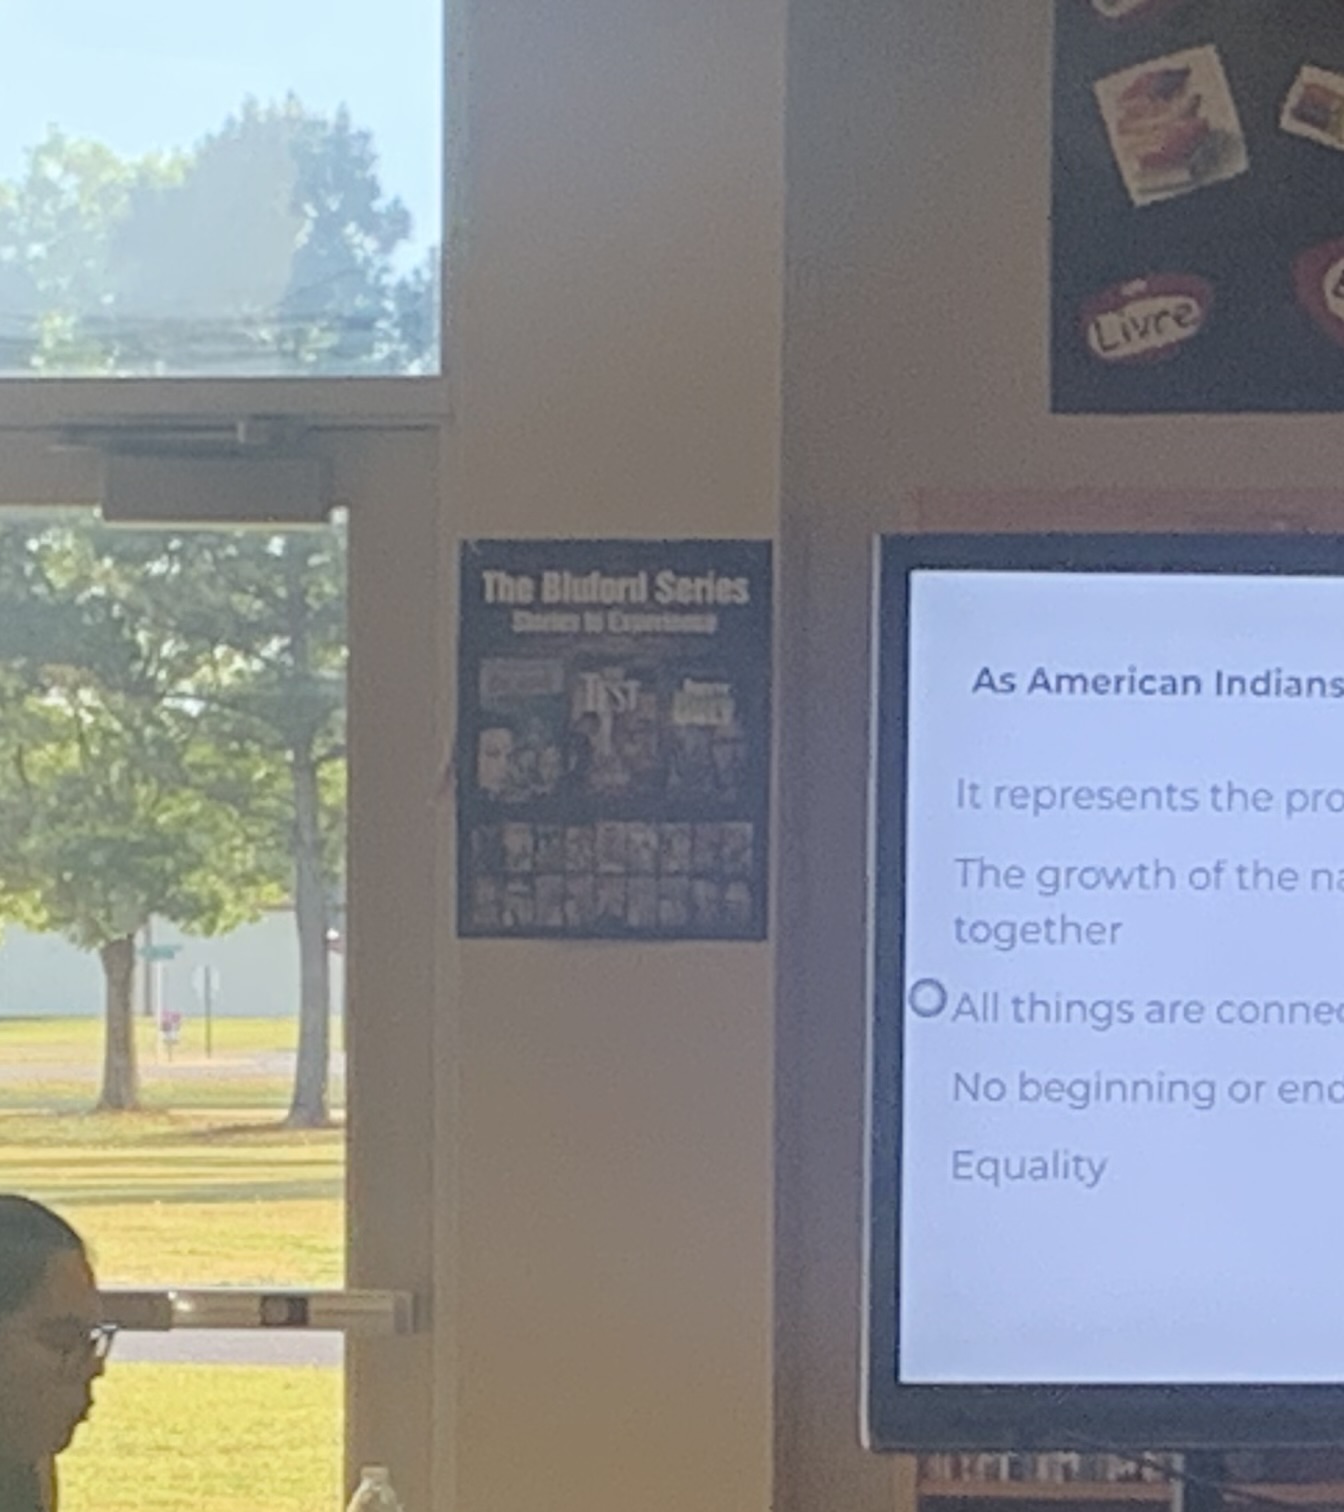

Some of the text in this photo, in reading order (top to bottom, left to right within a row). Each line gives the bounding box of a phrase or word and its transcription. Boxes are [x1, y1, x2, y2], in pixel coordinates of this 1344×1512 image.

[1094, 301, 1197, 353] Livre
[482, 570, 751, 605] The Bluford Series
[971, 665, 1018, 695] As
[1026, 664, 1203, 697] American
[957, 778, 982, 810] It
[994, 782, 1200, 817] represents
[1209, 780, 1274, 813] the
[953, 856, 1026, 889] The
[1035, 857, 1176, 901] growth
[1188, 859, 1227, 891] of
[1235, 859, 1300, 892] the
[954, 912, 1123, 954] together
[950, 991, 999, 1023] All
[1010, 991, 1135, 1032] things
[1144, 999, 1206, 1024] are
[953, 1072, 1007, 1102] No
[1018, 1070, 1216, 1111] beginning
[1227, 1079, 1267, 1105] or
[952, 1149, 1107, 1189] Equality
